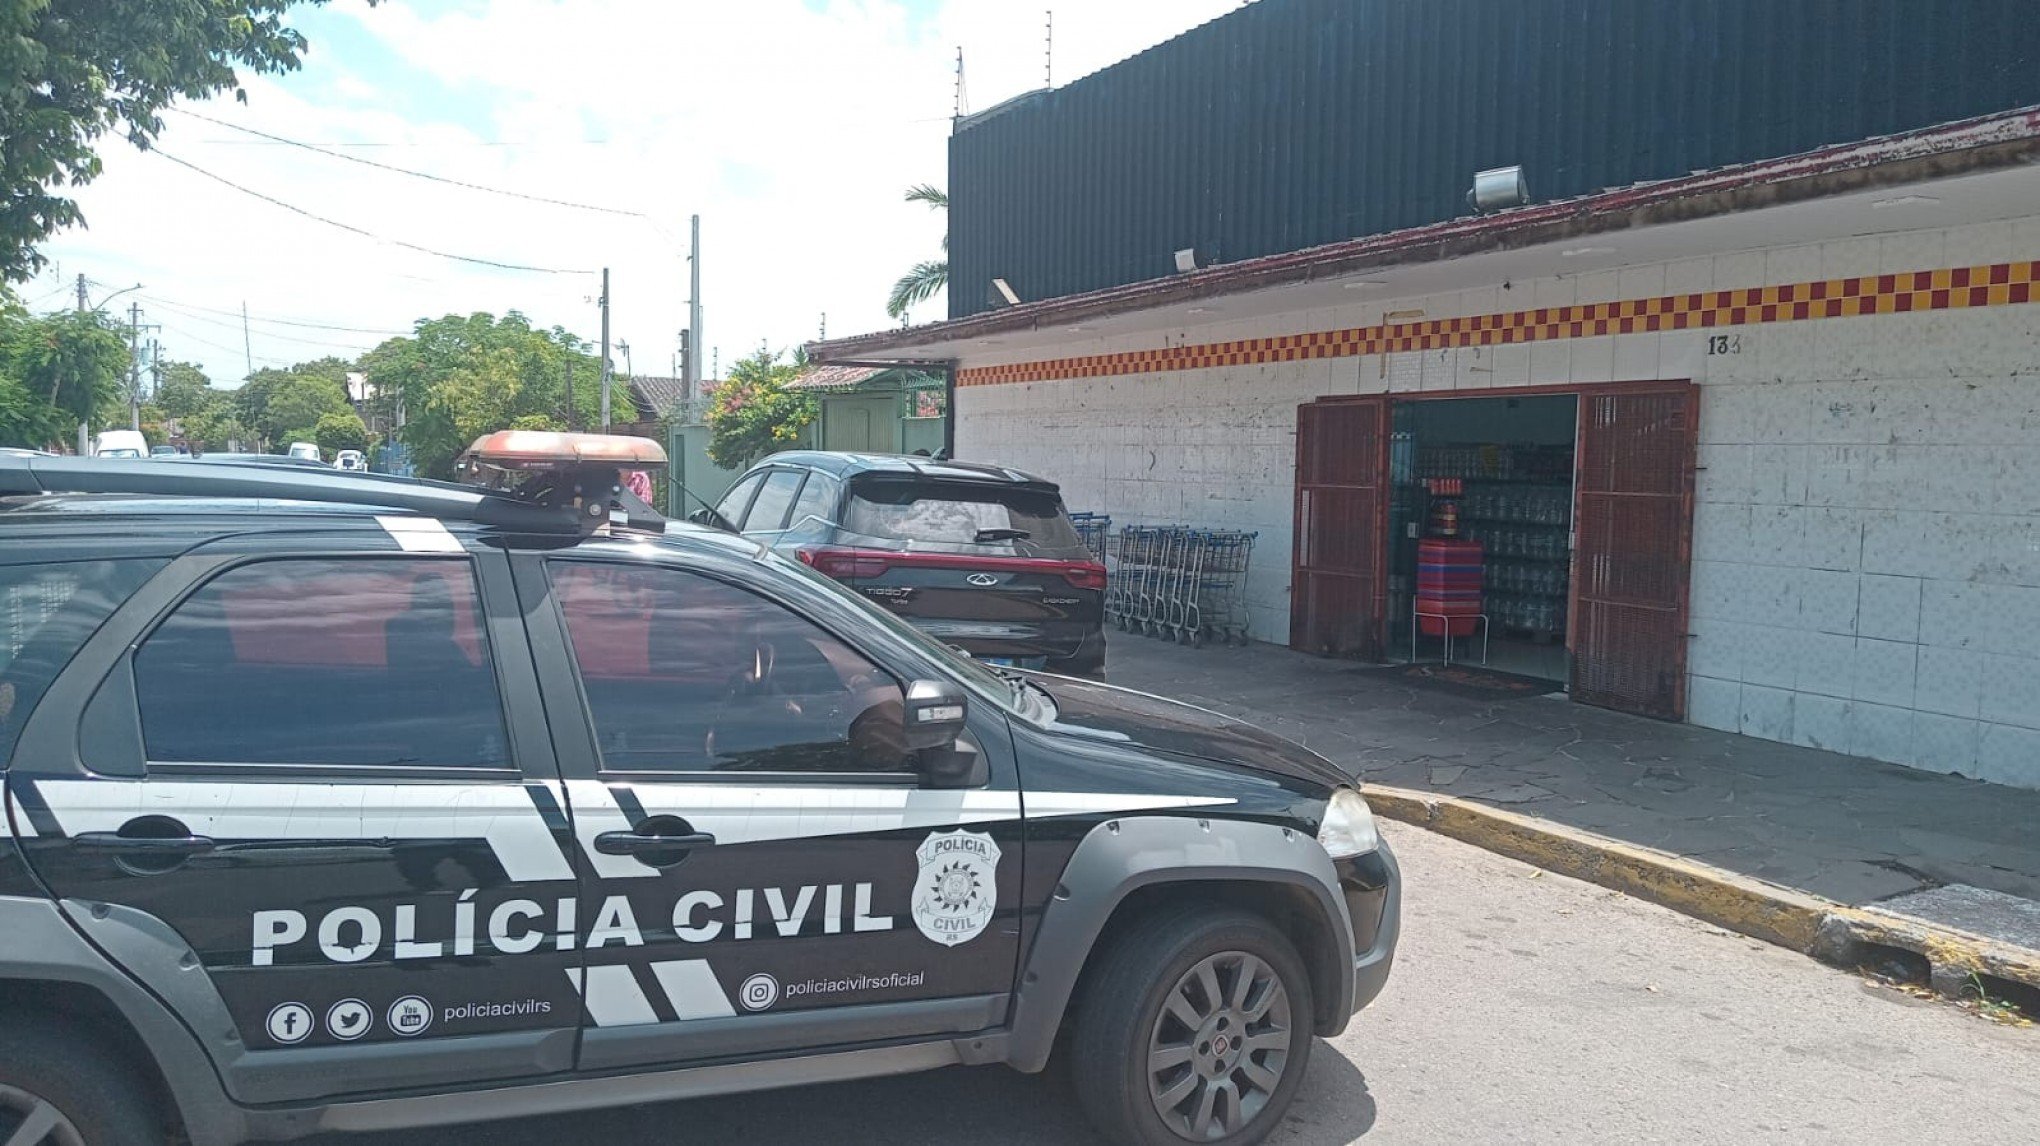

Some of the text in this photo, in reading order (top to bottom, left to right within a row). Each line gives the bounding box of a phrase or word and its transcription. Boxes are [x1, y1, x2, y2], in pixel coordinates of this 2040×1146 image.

[252, 881, 894, 966] POLÍCIA CIVIL
[933, 918, 976, 931] CIVIL
[786, 970, 925, 998] policiacivilrsoficial
[444, 999, 551, 1022] policiacivilrs
